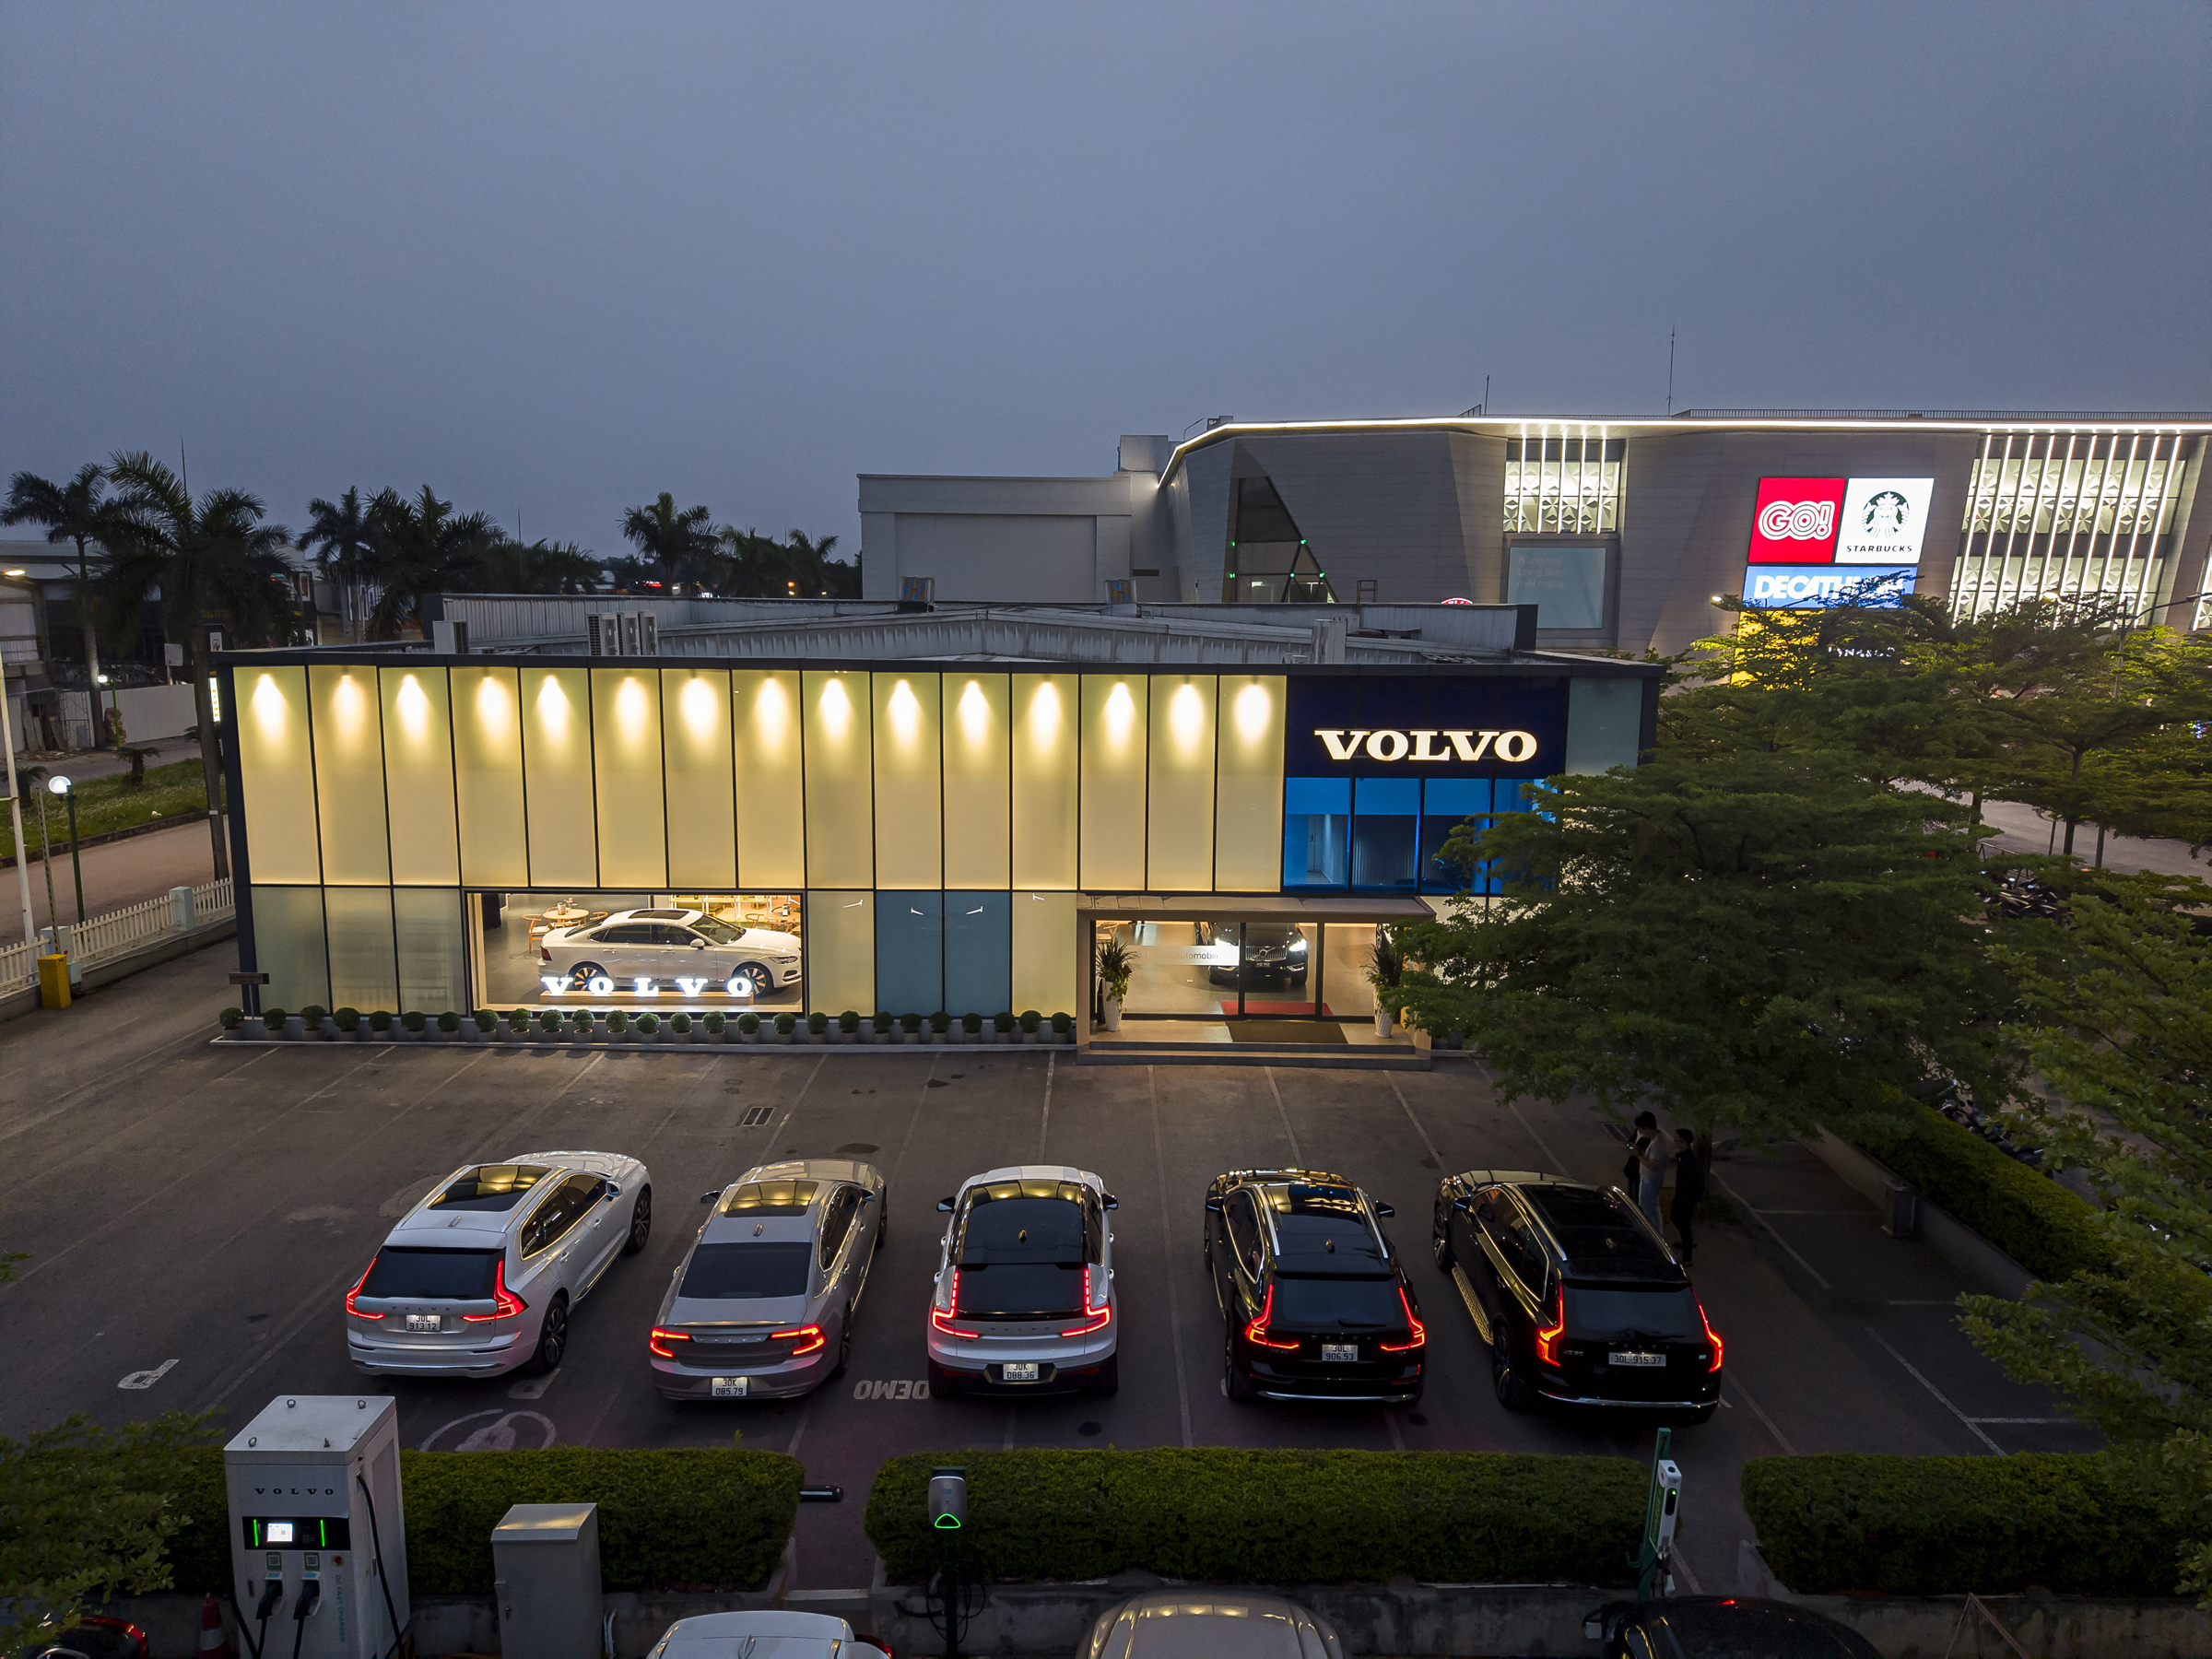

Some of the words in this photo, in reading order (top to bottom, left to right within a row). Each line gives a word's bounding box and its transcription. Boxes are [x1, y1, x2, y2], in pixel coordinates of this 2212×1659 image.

[1759, 500, 1835, 540] GO!
[1754, 575, 1903, 599] DECATH
[1314, 730, 1537, 761] VOLVO
[541, 977, 753, 996] VOLVO
[1325, 1352, 1354, 1360] 906.53
[715, 1387, 744, 1395] 085.79
[722, 1378, 737, 1387] 30K
[853, 1380, 930, 1400] DEMO
